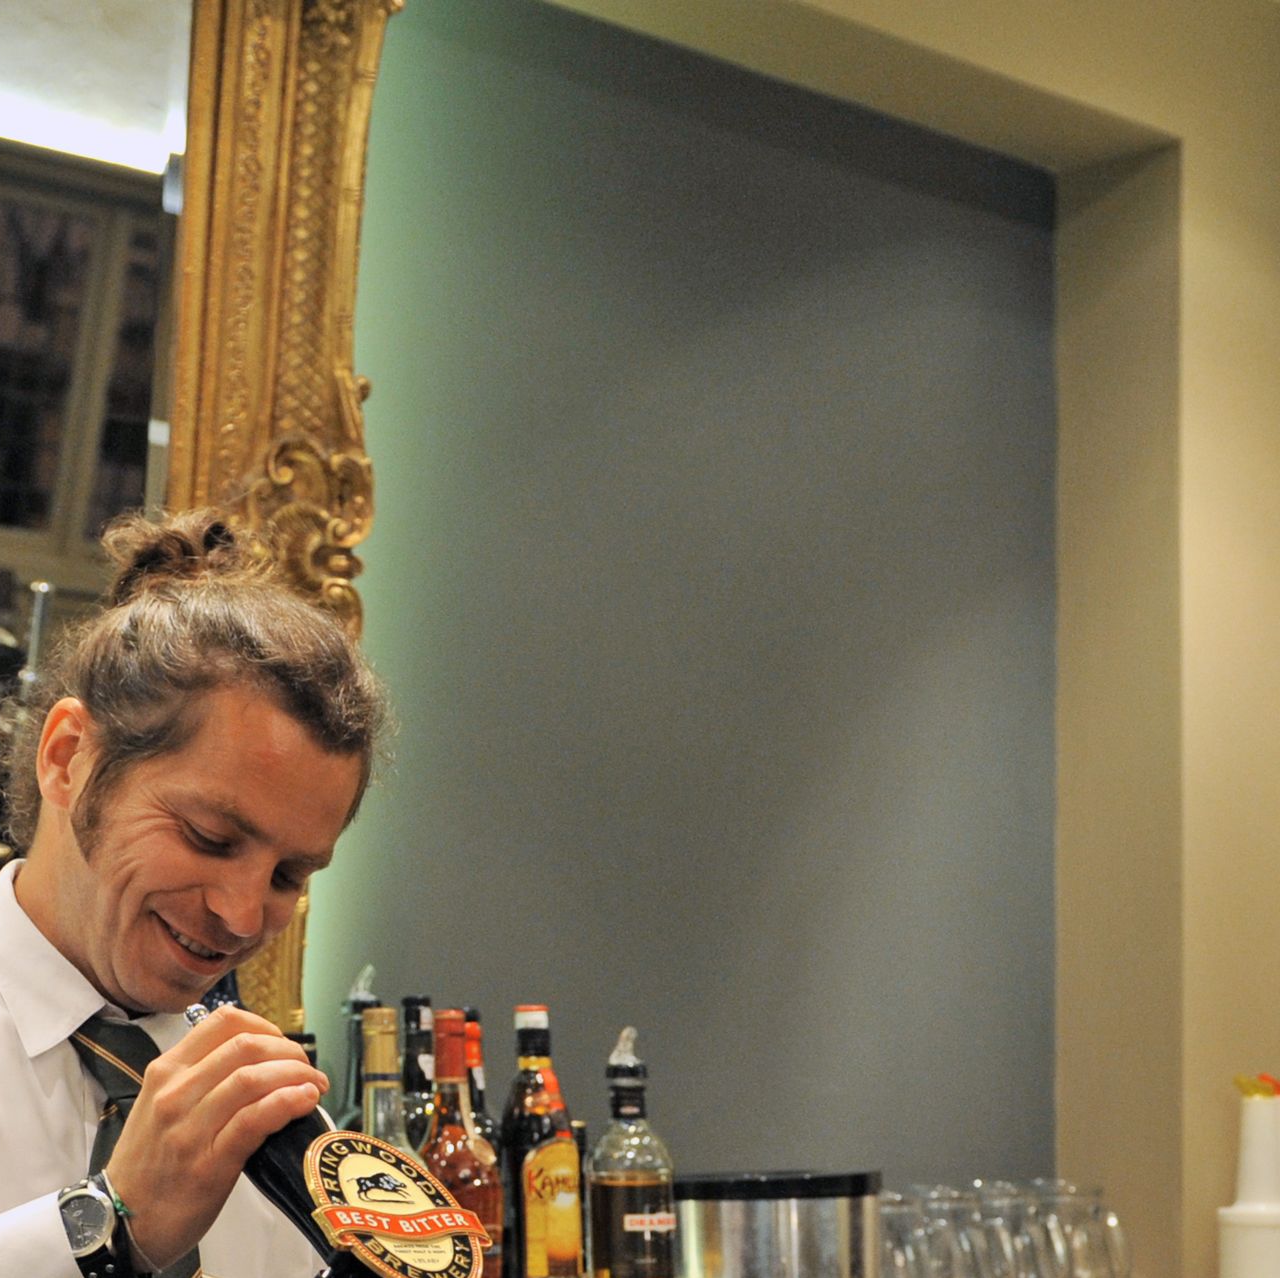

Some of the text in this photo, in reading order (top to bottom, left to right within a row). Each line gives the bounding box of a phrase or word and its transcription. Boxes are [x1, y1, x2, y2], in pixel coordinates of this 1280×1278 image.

[320, 1138, 436, 1196] RINGWOOD
[335, 1211, 470, 1234] BEST BITTER
